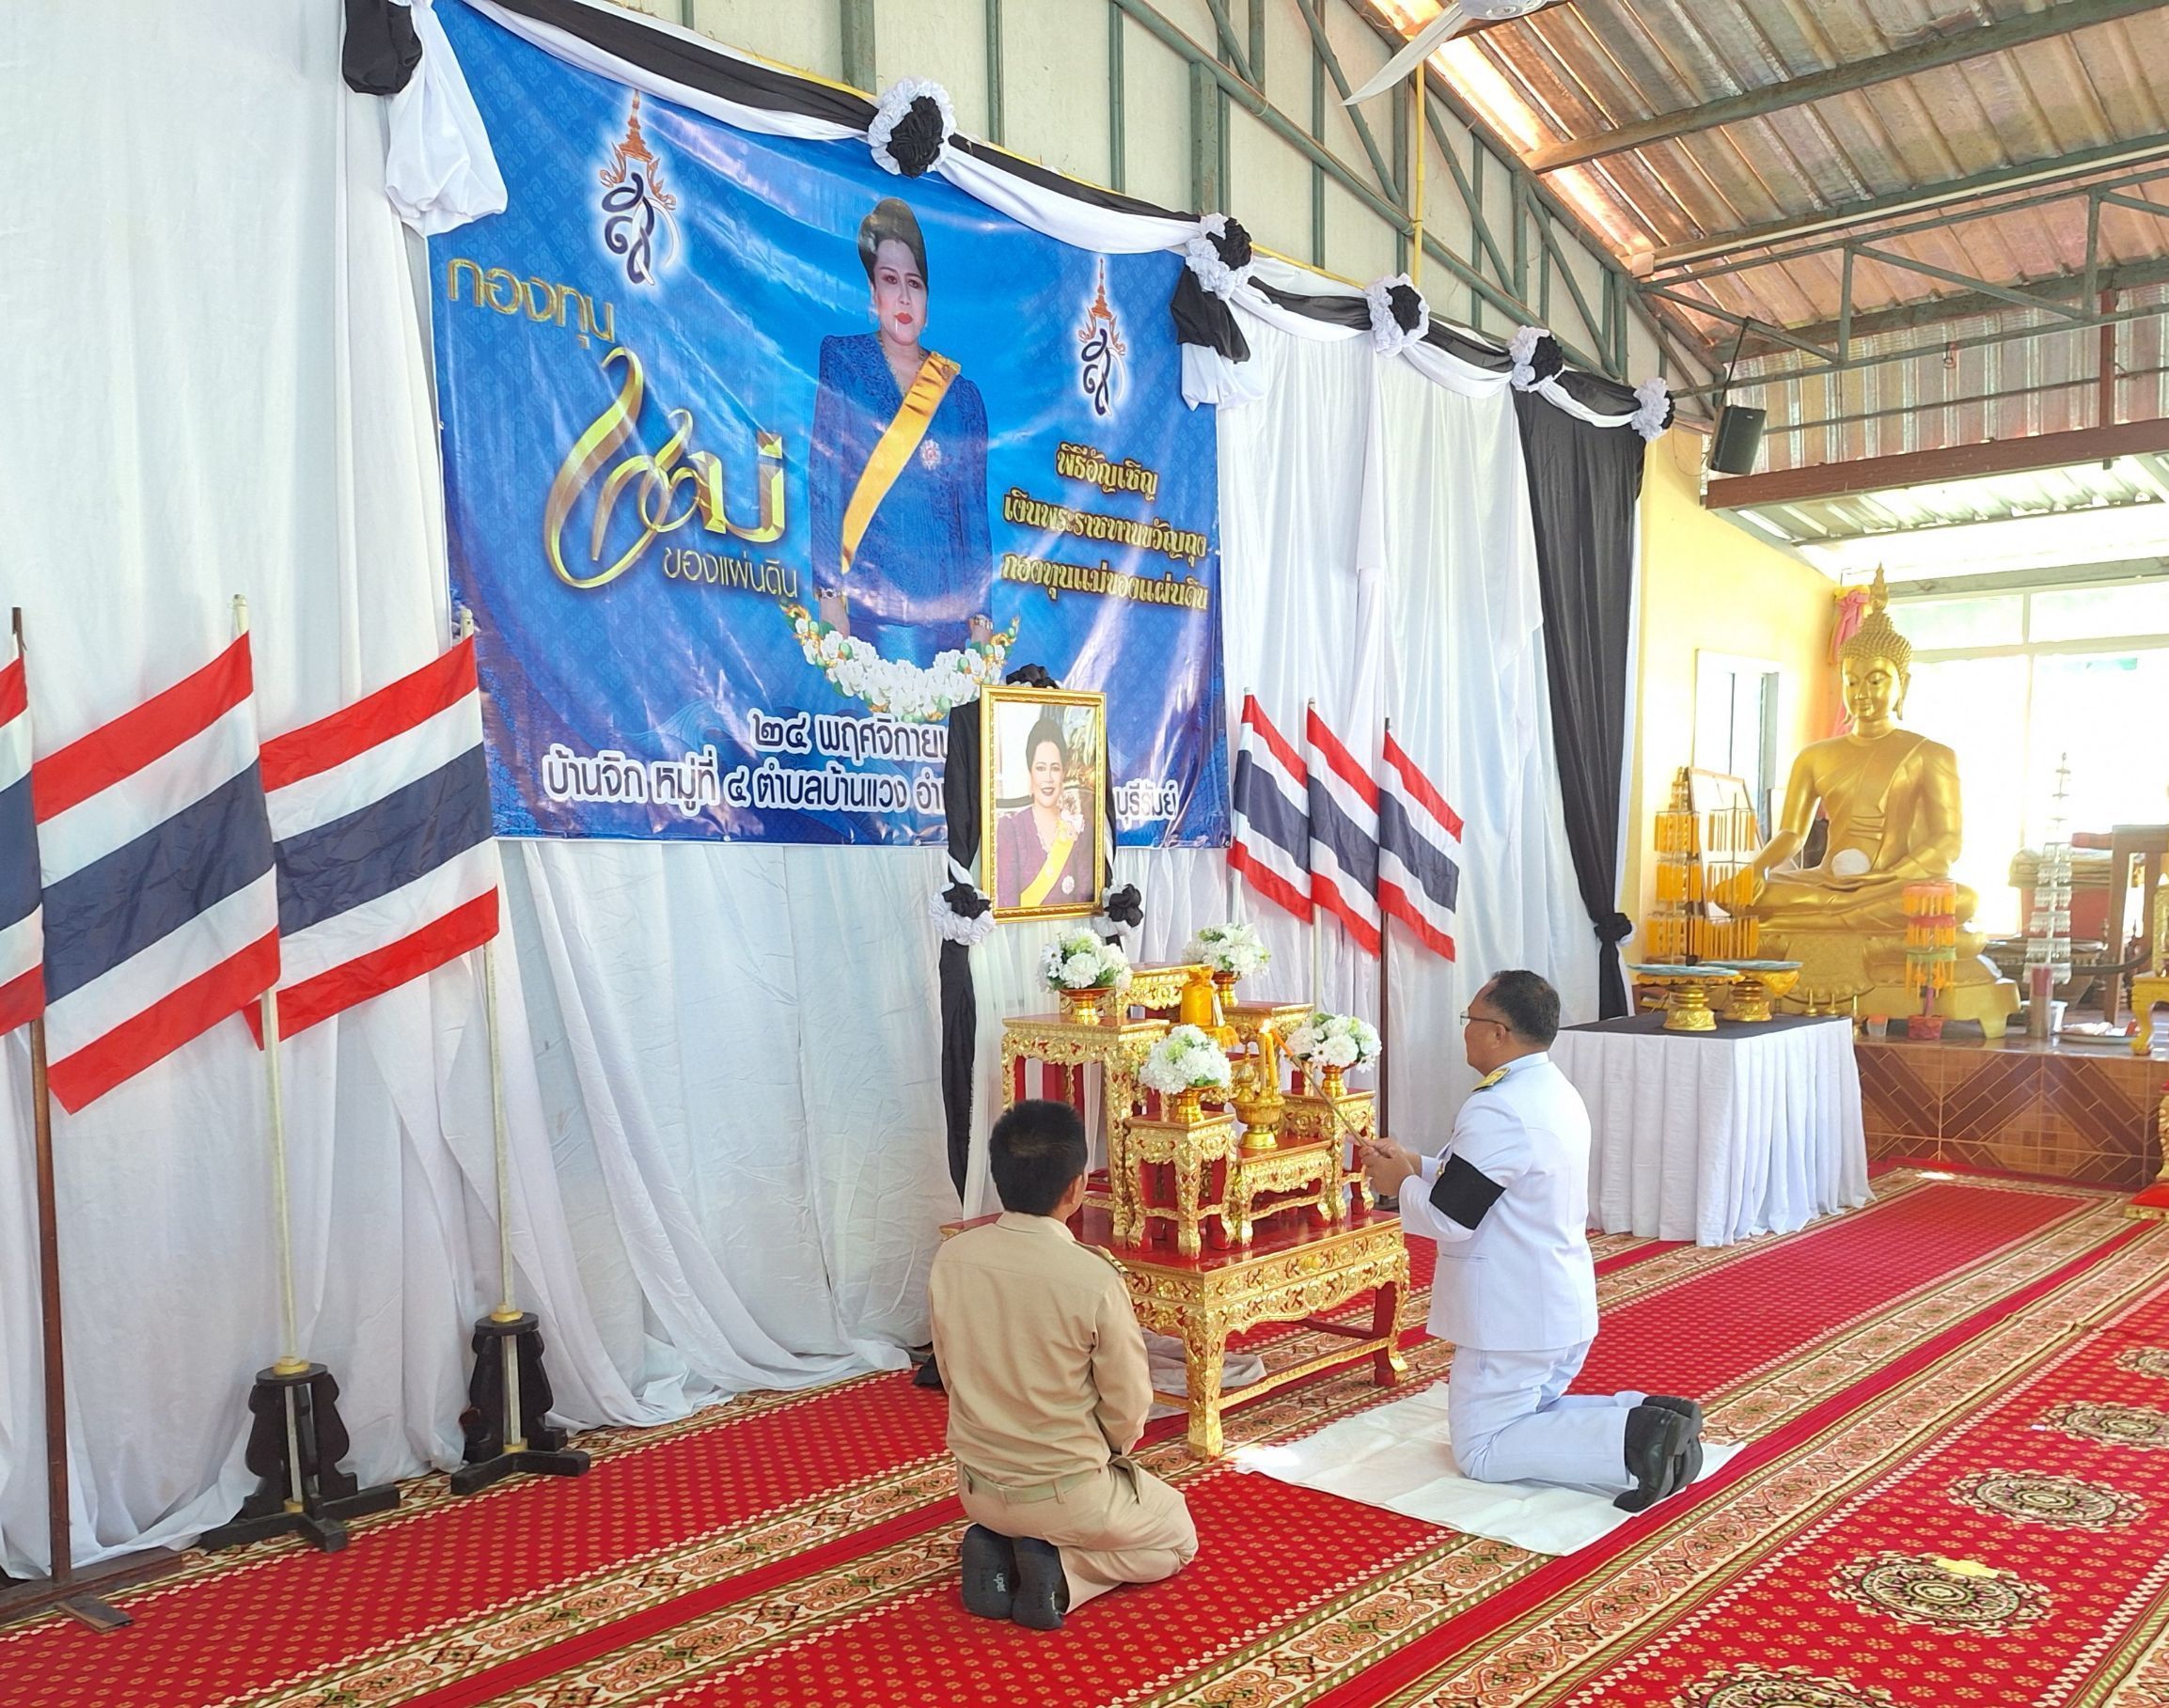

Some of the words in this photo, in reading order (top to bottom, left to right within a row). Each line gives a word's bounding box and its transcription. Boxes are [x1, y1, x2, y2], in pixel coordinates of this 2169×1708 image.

[447, 258, 615, 349] กองทุน
[1057, 442, 1159, 501] พิธีอัญเชิญ
[1004, 488, 1207, 568] เงินพระราชทานขวัญถุง
[664, 547, 797, 599] ของแผ่นดิน
[1002, 555, 1208, 610] กองทุนแม่ของแผ่นดิน
[548, 749, 644, 798] บ้านจิก
[655, 750, 716, 811] หมู่ที่
[757, 762, 908, 808] ตำบลบ้านแวง
[916, 772, 945, 809] อำ
